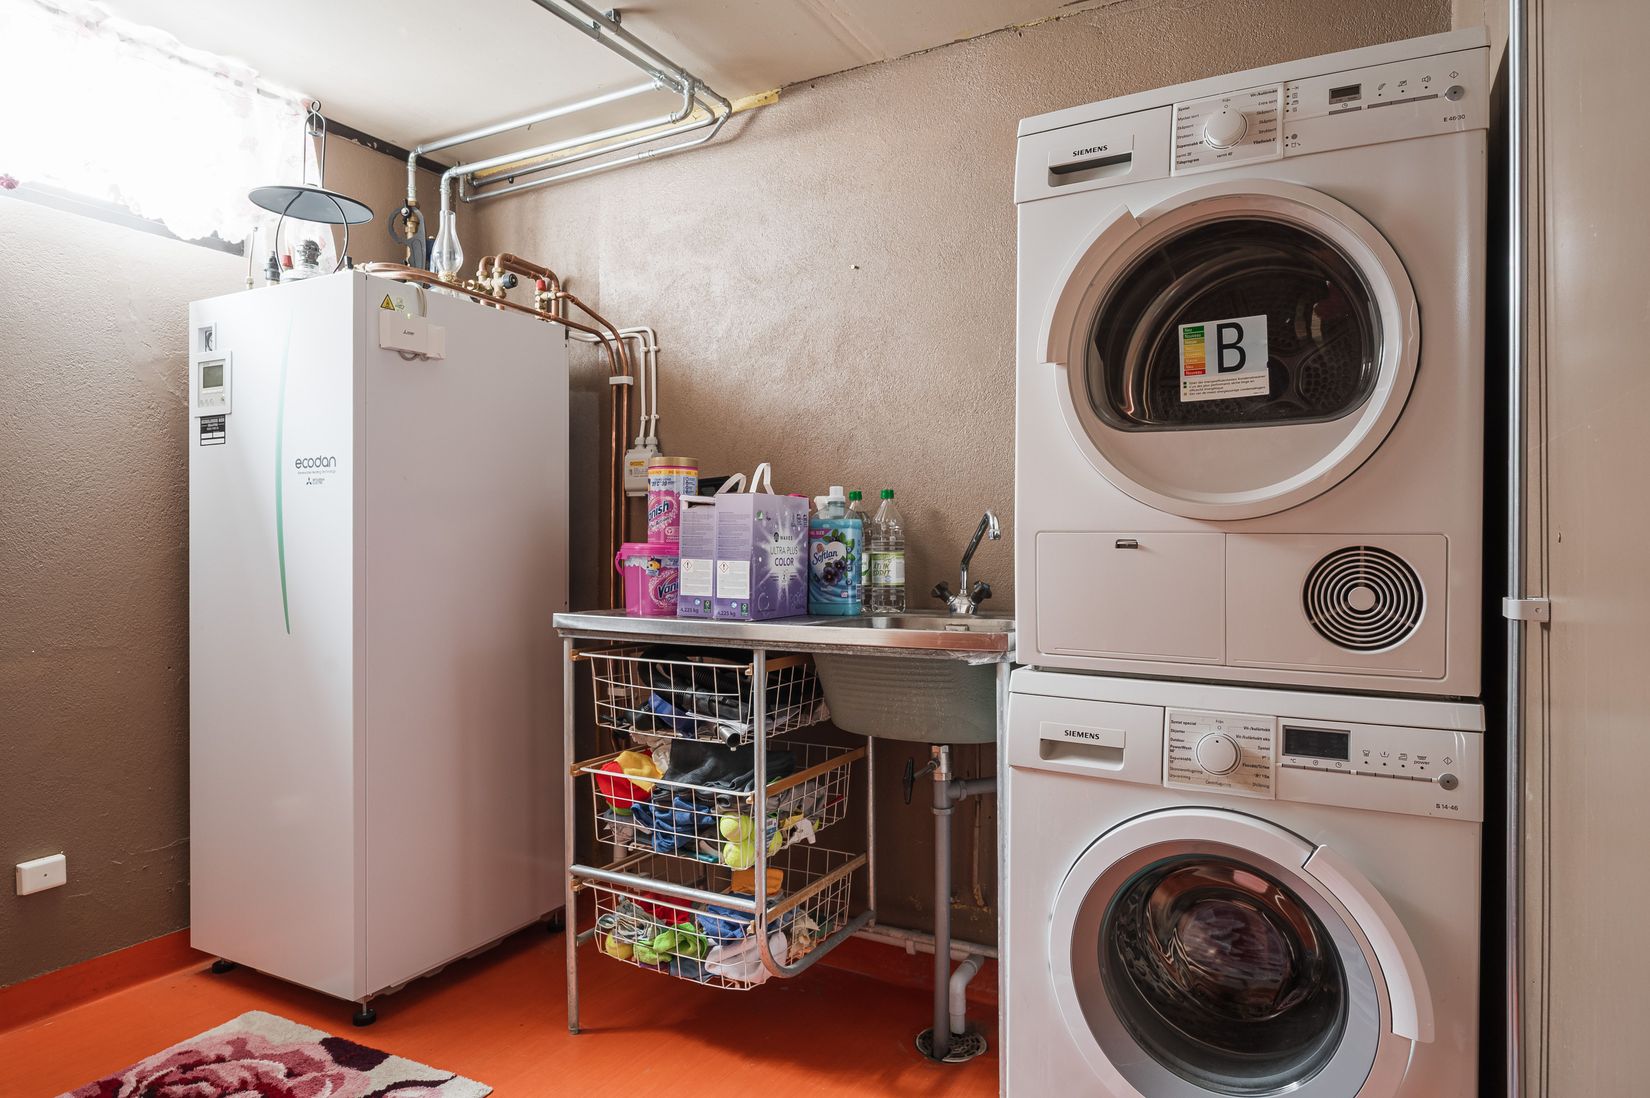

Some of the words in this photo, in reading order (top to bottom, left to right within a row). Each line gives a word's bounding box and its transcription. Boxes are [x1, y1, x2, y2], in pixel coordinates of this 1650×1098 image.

[1073, 145, 1108, 157] SIEMENS
[1217, 322, 1246, 373] B
[295, 455, 336, 469] ecodan
[770, 546, 786, 555] ULTRA
[787, 546, 798, 555] PLUS
[775, 558, 794, 566] COLOR
[812, 550, 838, 565] Softlan
[1064, 729, 1100, 740] SIEMENS
